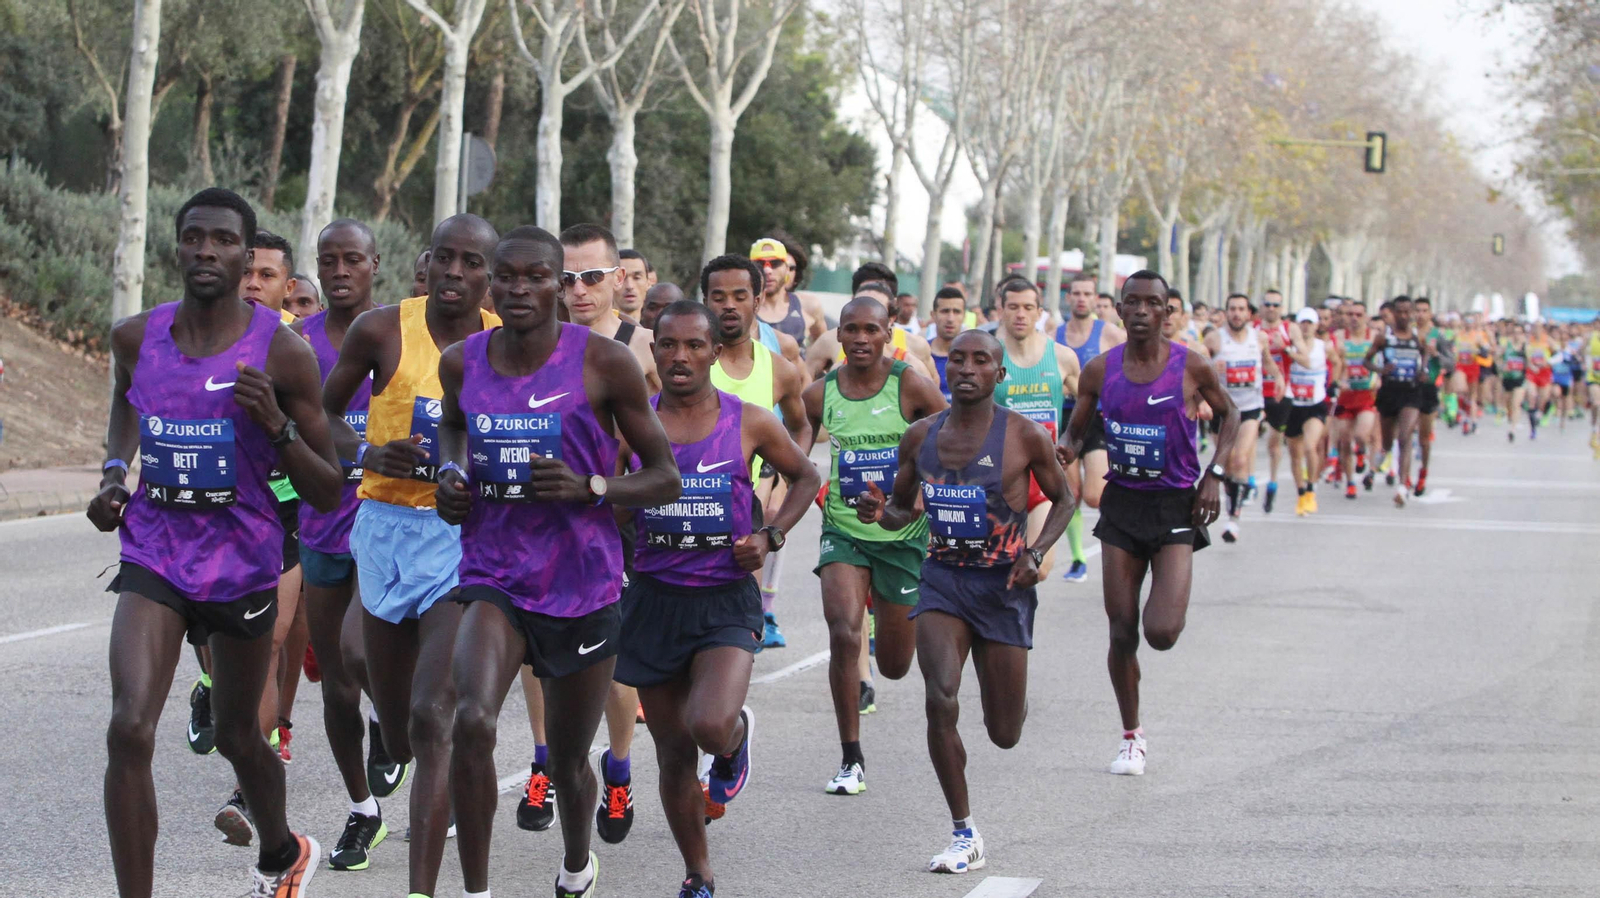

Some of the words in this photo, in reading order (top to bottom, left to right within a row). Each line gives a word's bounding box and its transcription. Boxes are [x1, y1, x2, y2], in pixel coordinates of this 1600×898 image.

[1008, 382, 1049, 396] BIKILA
[166, 423, 222, 436] ZURICH
[494, 418, 549, 430] ZURICH
[1122, 426, 1158, 436] ZURICH
[500, 447, 530, 463] AYEKO
[858, 449, 894, 461] ZURICH
[1124, 444, 1145, 456] KOECH
[173, 452, 198, 468] BETT
[178, 474, 188, 484] 95
[508, 469, 517, 480] 94
[682, 478, 720, 488] URICH
[936, 488, 976, 498] ZURICH
[938, 509, 966, 523] MOKAYA
[682, 521, 692, 531] 25
